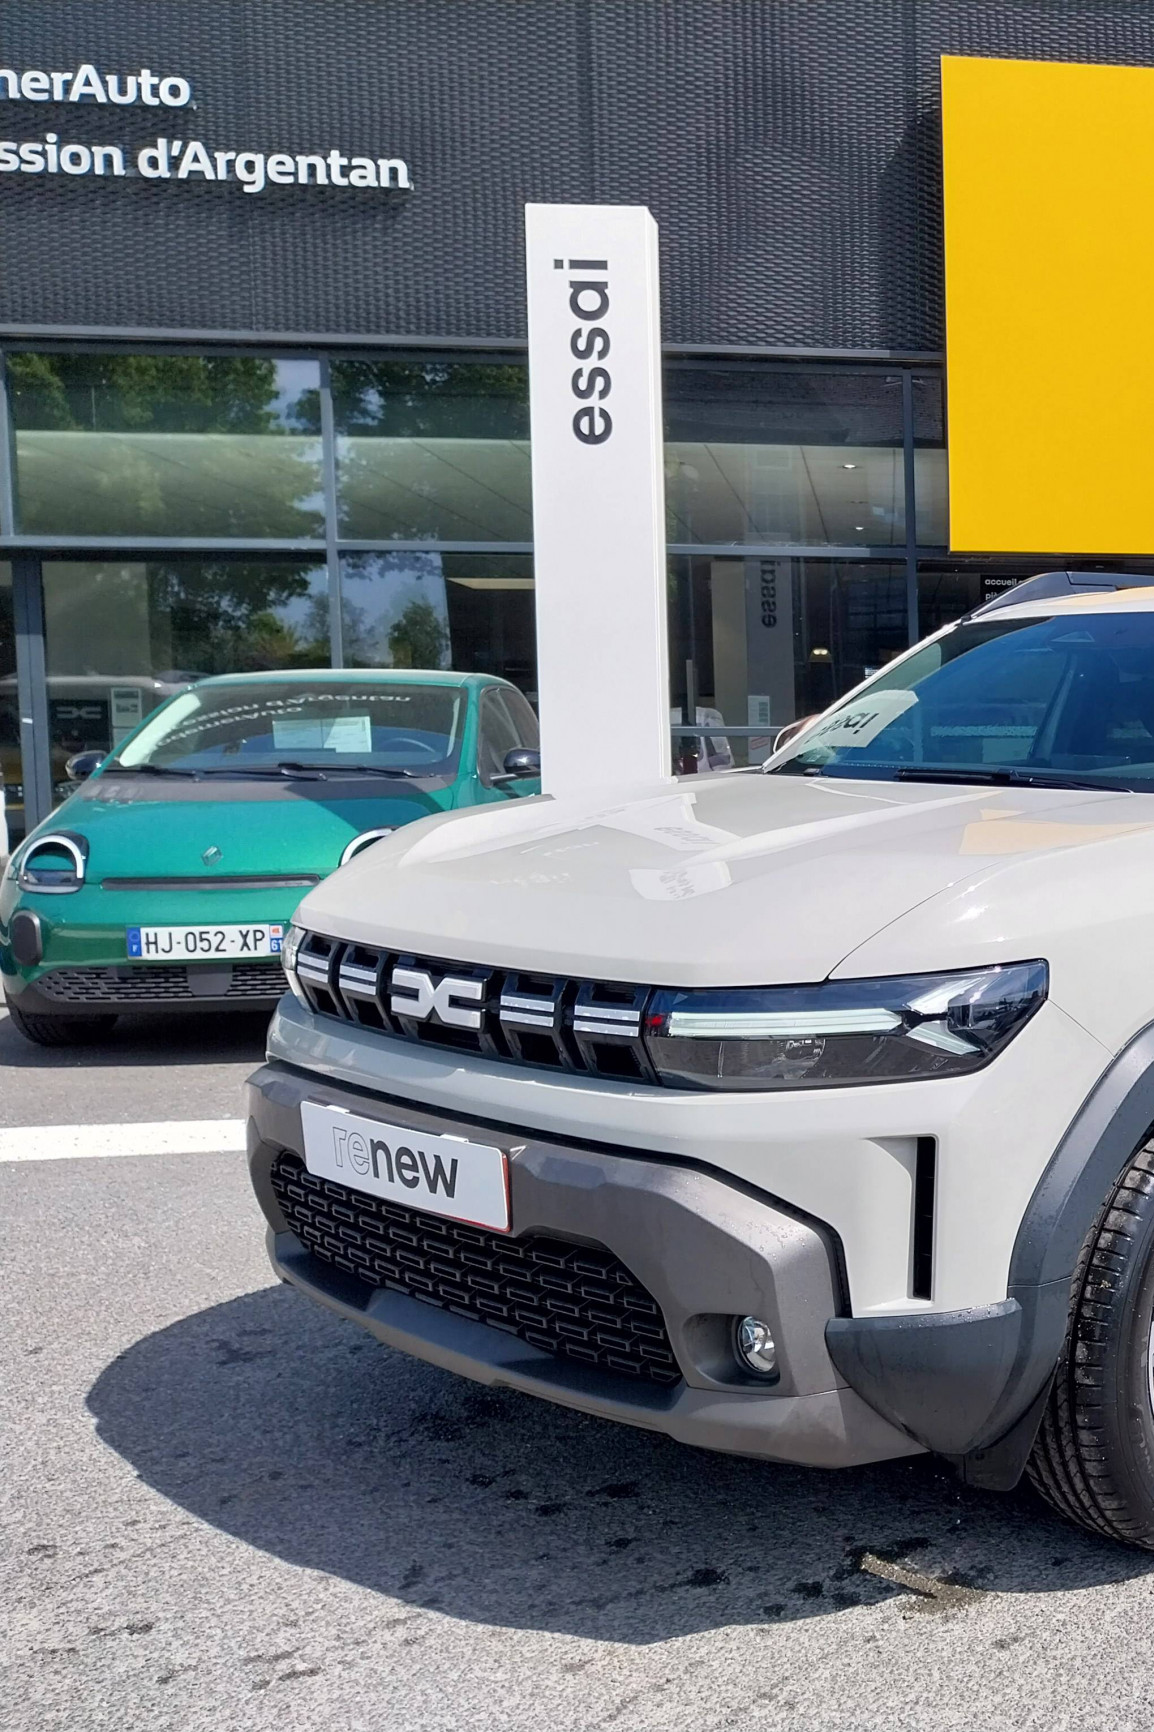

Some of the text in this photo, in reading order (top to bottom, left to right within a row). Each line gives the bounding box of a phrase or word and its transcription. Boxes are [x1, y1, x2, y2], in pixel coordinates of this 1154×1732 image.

[0, 132, 410, 193] ssion d'Argentan
[553, 258, 613, 446] essai
[145, 929, 266, 955] HJ-052-XP
[332, 1126, 459, 1199] renew
